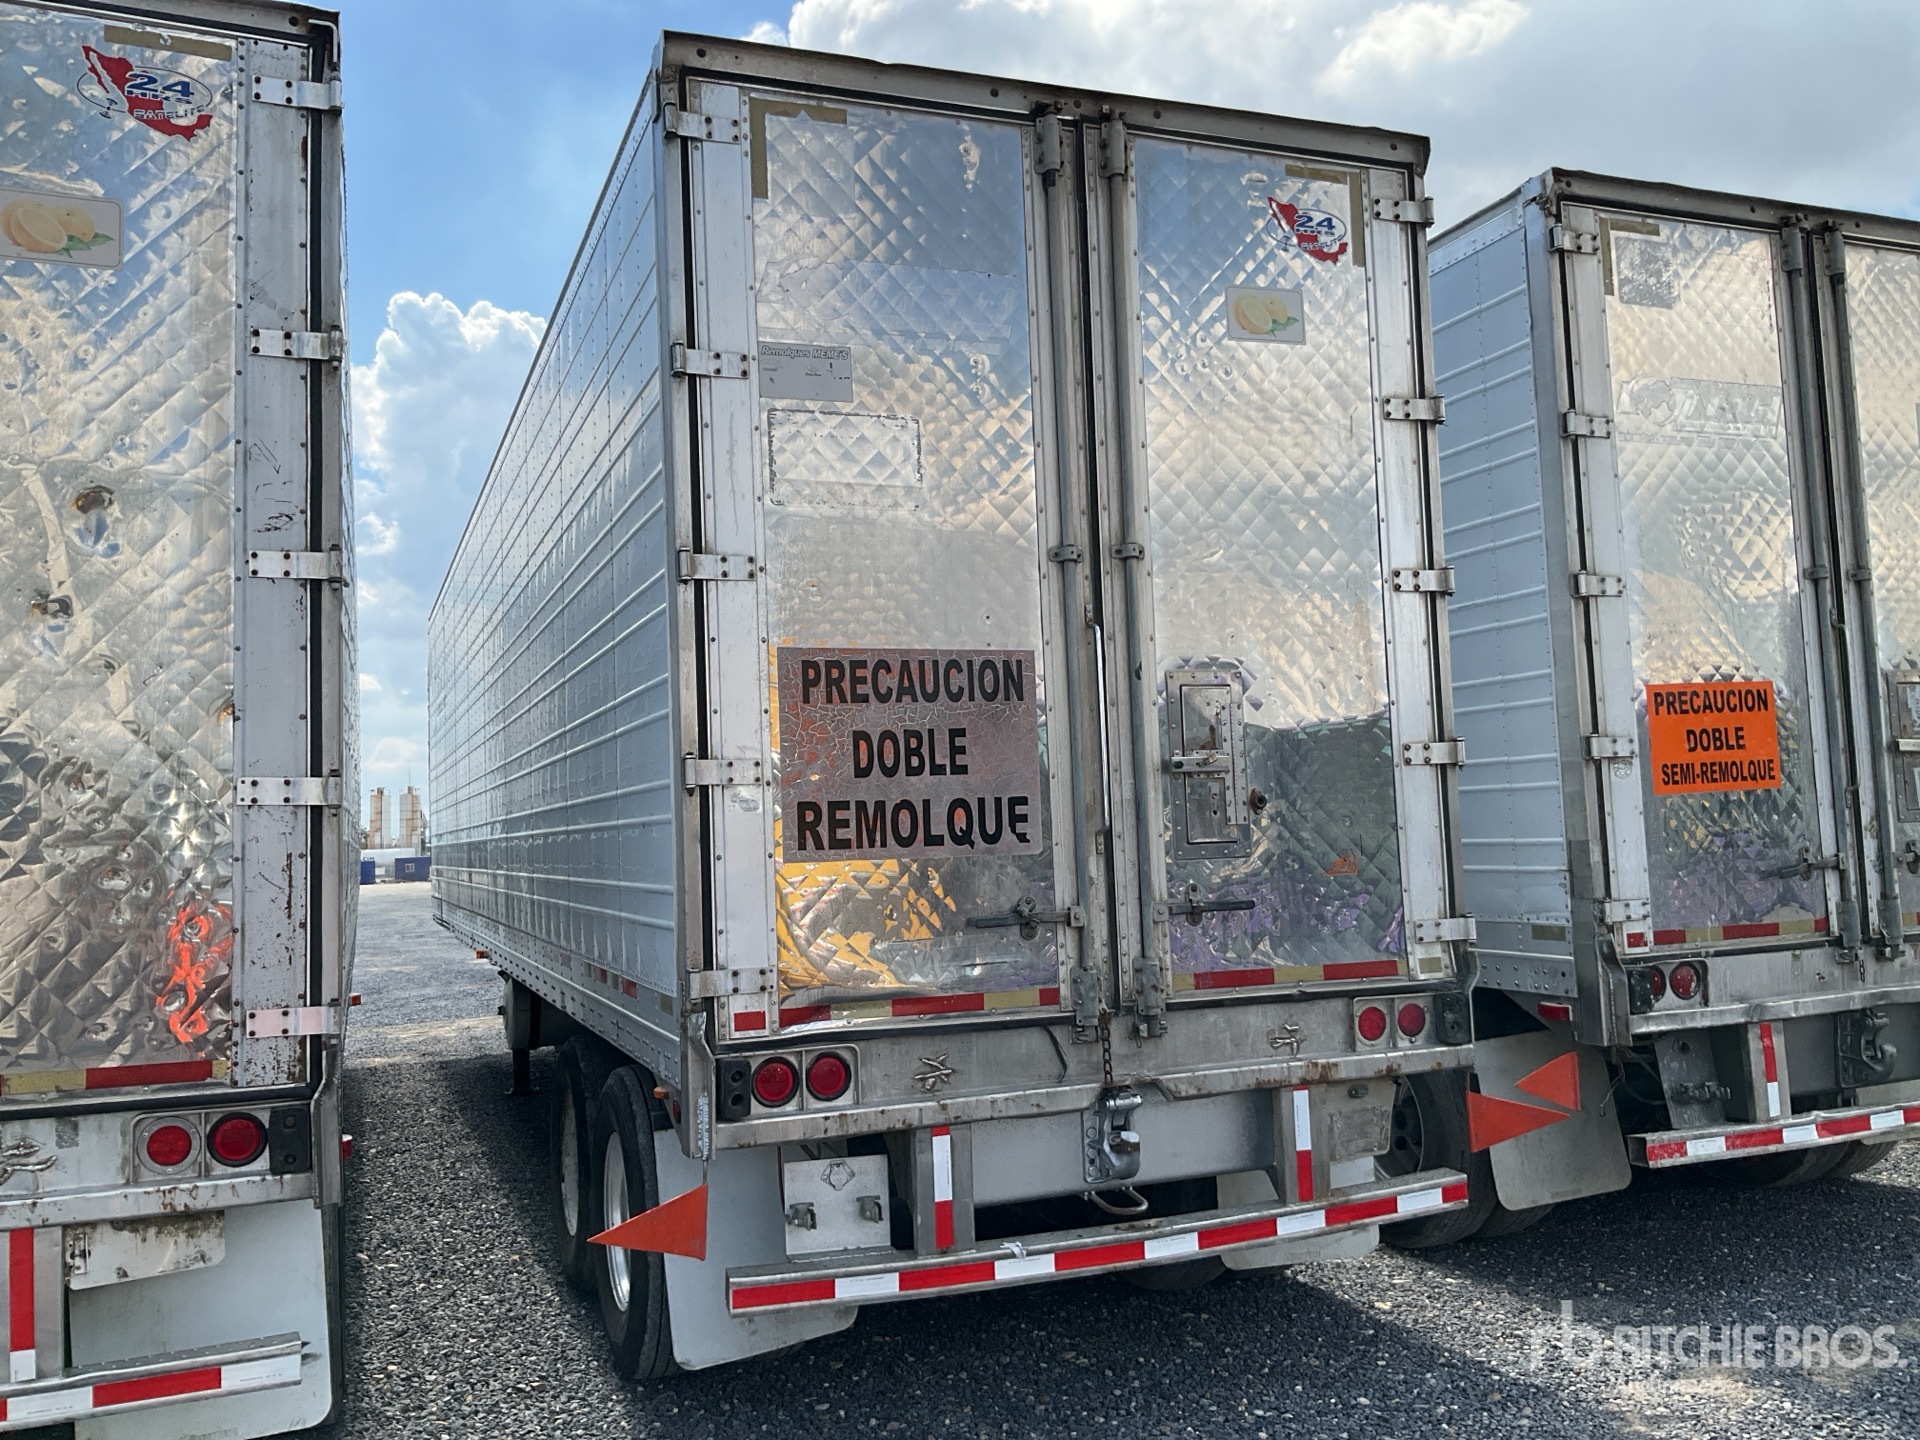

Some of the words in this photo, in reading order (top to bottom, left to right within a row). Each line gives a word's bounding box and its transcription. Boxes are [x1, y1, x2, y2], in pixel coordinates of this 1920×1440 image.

[125, 72, 194, 98] 24
[134, 104, 204, 119] SATELITE
[1295, 214, 1335, 231] 24
[761, 345, 811, 359] Remolques
[811, 348, 849, 360] MEME'S
[801, 659, 1024, 705] PRECAUCION
[1653, 689, 1769, 716] PRECAUCION
[1686, 726, 1747, 752] DOBLE
[852, 728, 969, 779] DOBLE
[1661, 759, 1776, 786] SEMI-REMOLQUE
[797, 796, 1031, 851] REMOLQUE
